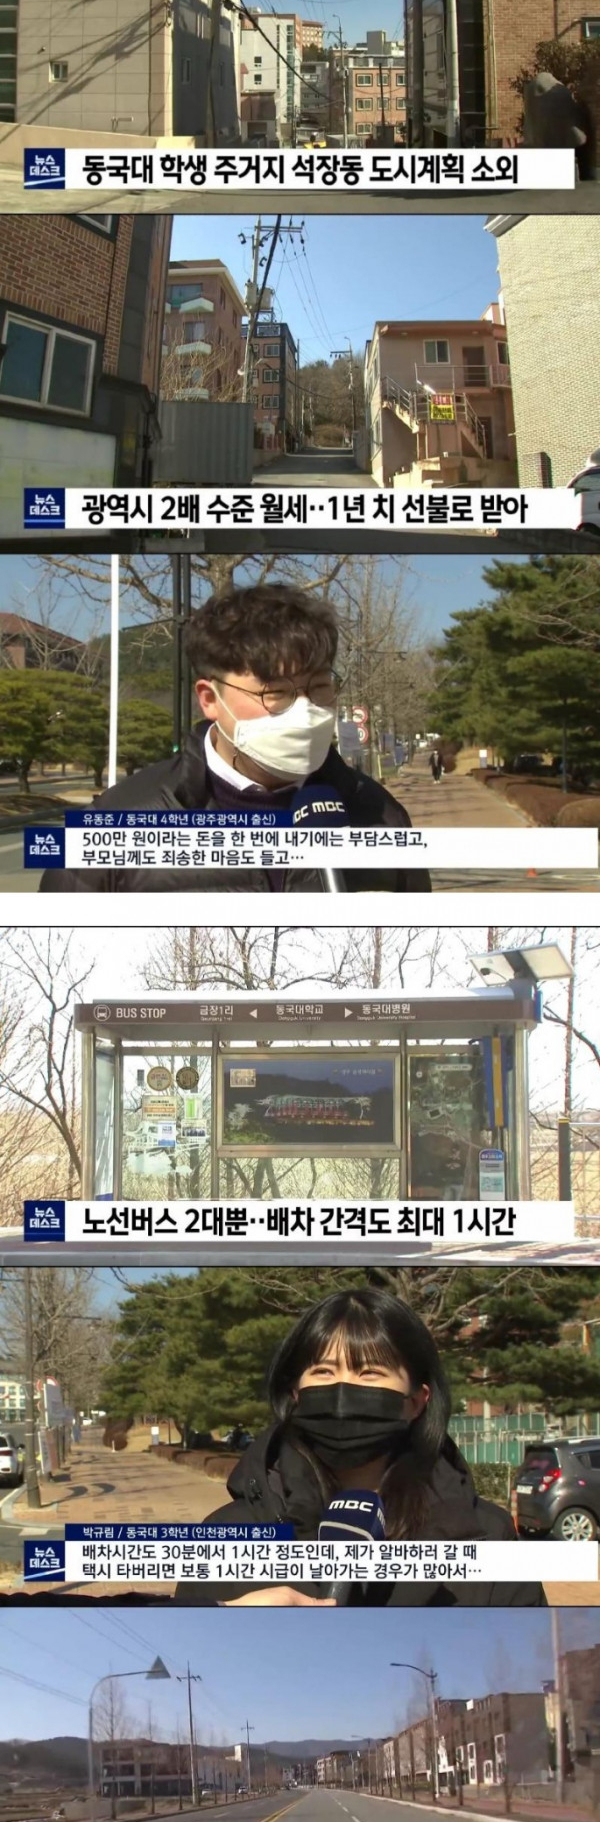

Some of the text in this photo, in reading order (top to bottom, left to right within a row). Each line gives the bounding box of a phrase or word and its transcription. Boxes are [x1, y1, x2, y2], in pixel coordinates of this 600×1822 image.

[311, 801, 345, 813] MBC
[116, 1007, 167, 1019] BUS STOP
[276, 1004, 323, 1015] 동국대학교
[362, 1003, 411, 1015] 동국대병원
[328, 1499, 374, 1512] MBC
